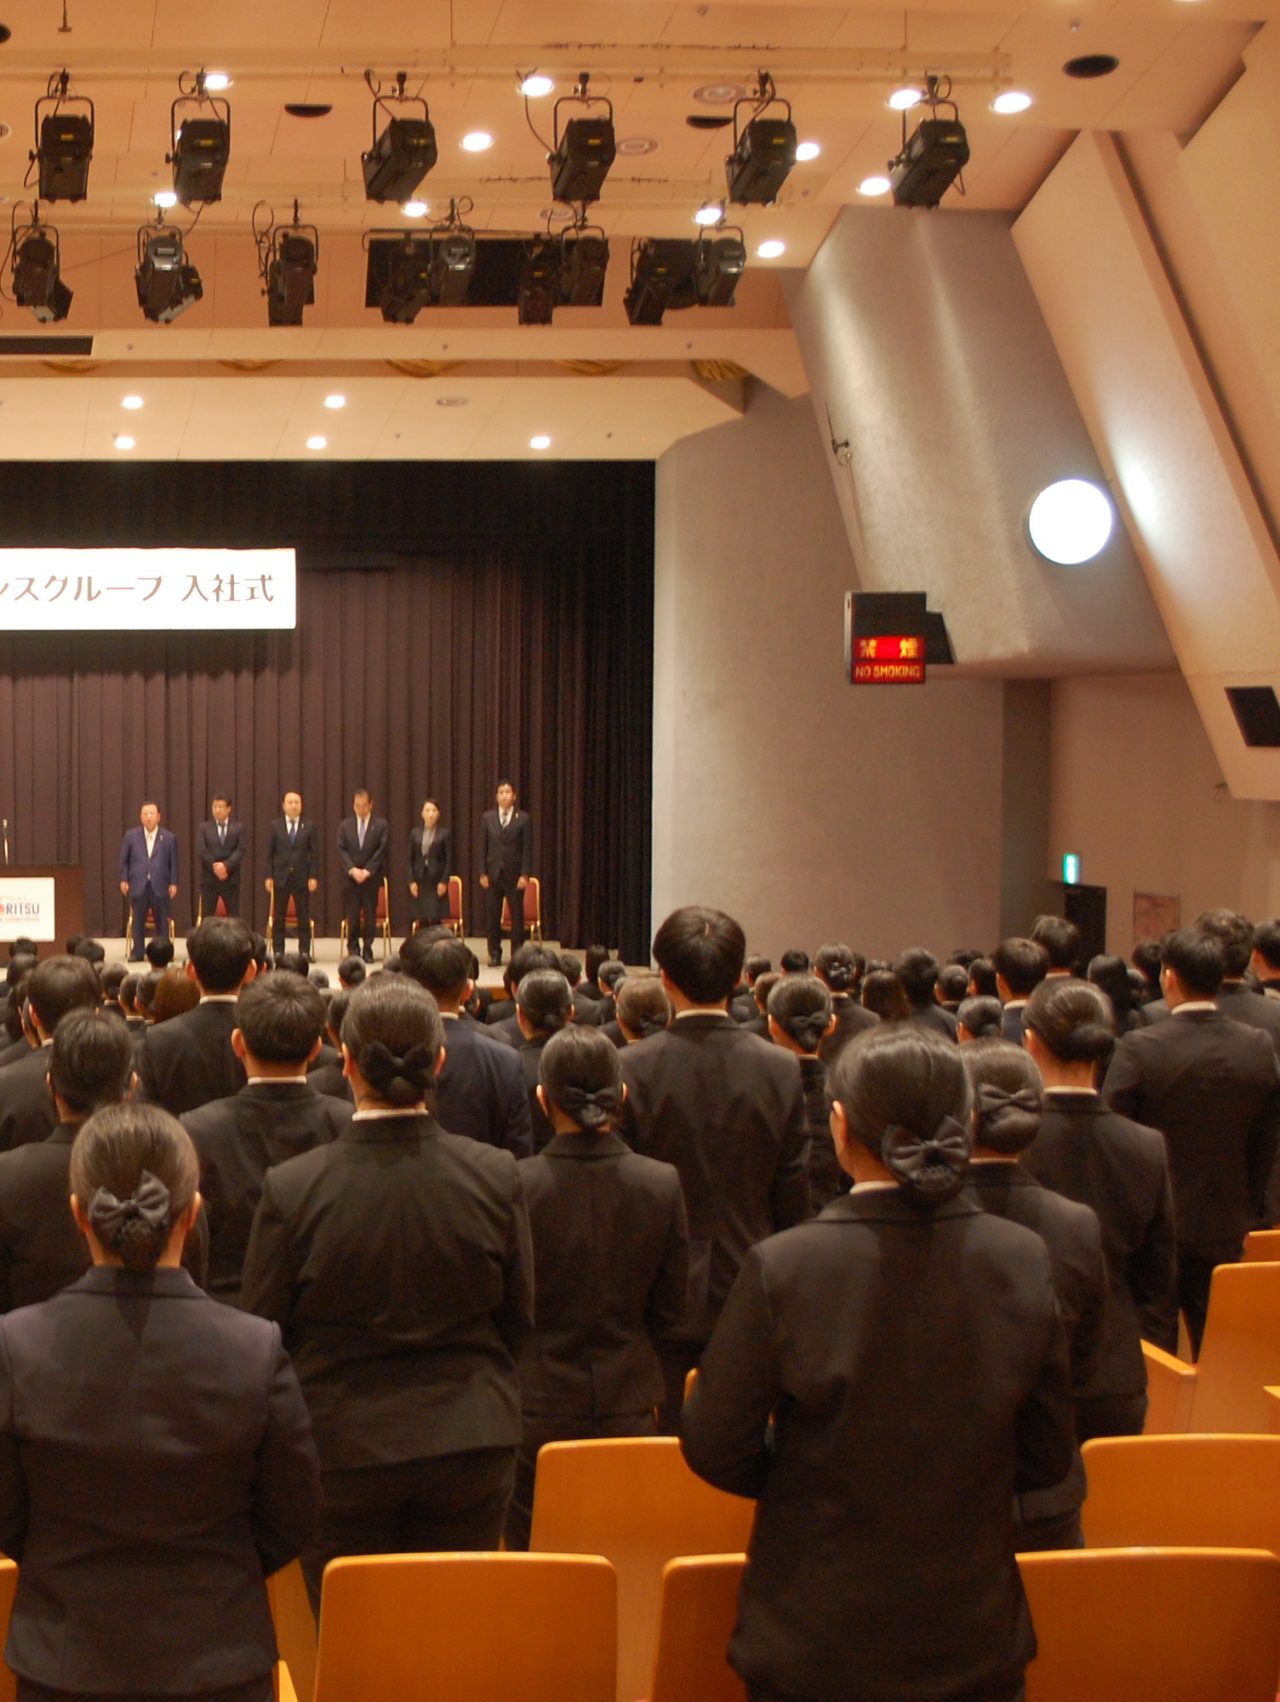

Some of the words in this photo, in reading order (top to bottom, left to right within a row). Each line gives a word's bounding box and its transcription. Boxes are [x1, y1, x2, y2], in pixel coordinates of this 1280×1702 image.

[181, 573, 275, 603] 入社式
[855, 665, 871, 678] NO
[873, 665, 921, 678] SMOKING
